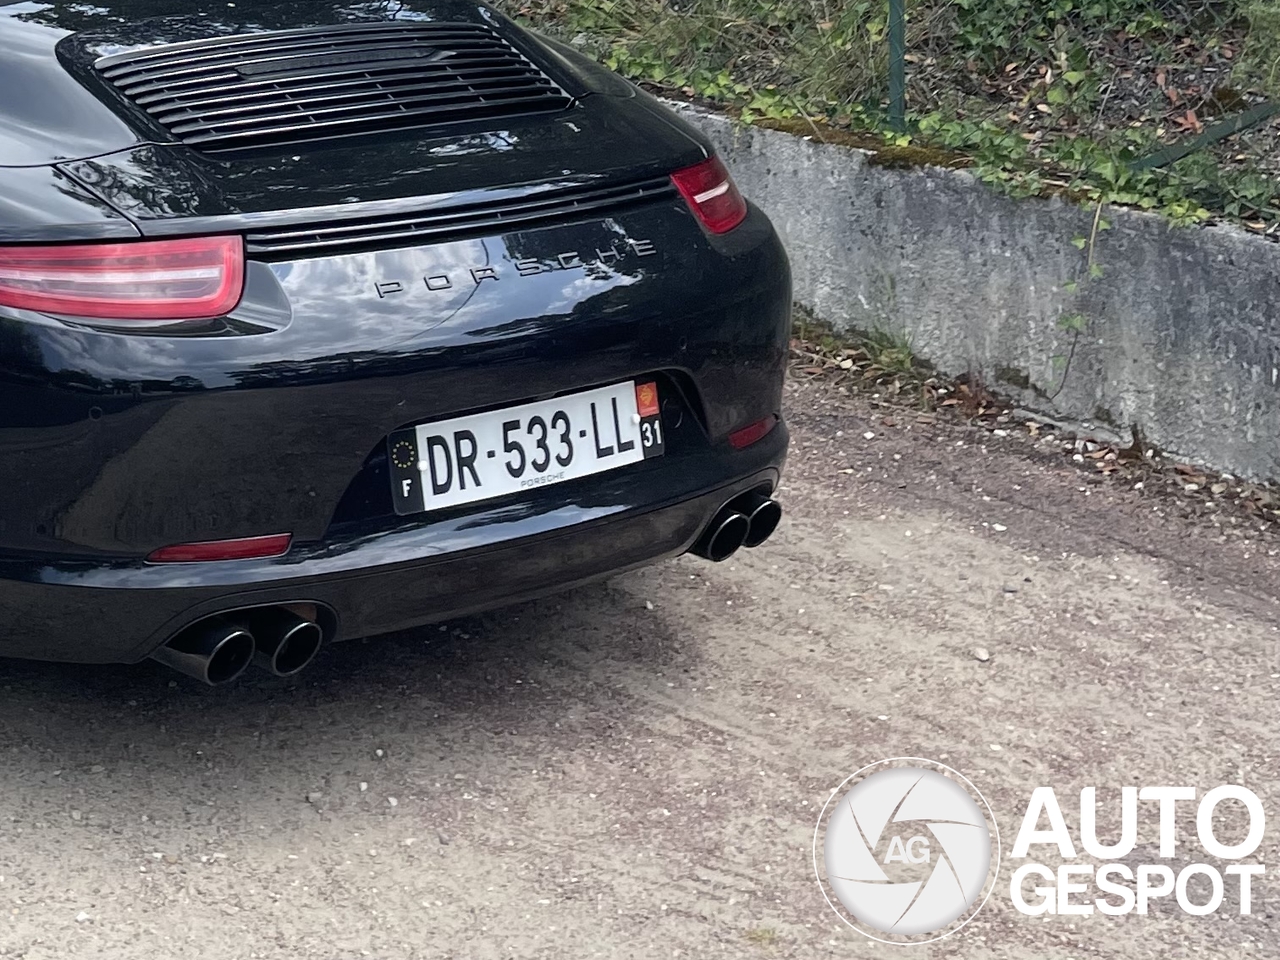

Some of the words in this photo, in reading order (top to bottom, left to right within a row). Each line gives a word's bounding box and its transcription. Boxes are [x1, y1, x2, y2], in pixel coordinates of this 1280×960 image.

[374, 239, 657, 298] PORSCHE
[642, 420, 662, 447] 31
[401, 479, 412, 497] F
[521, 471, 565, 487] PORSCHE
